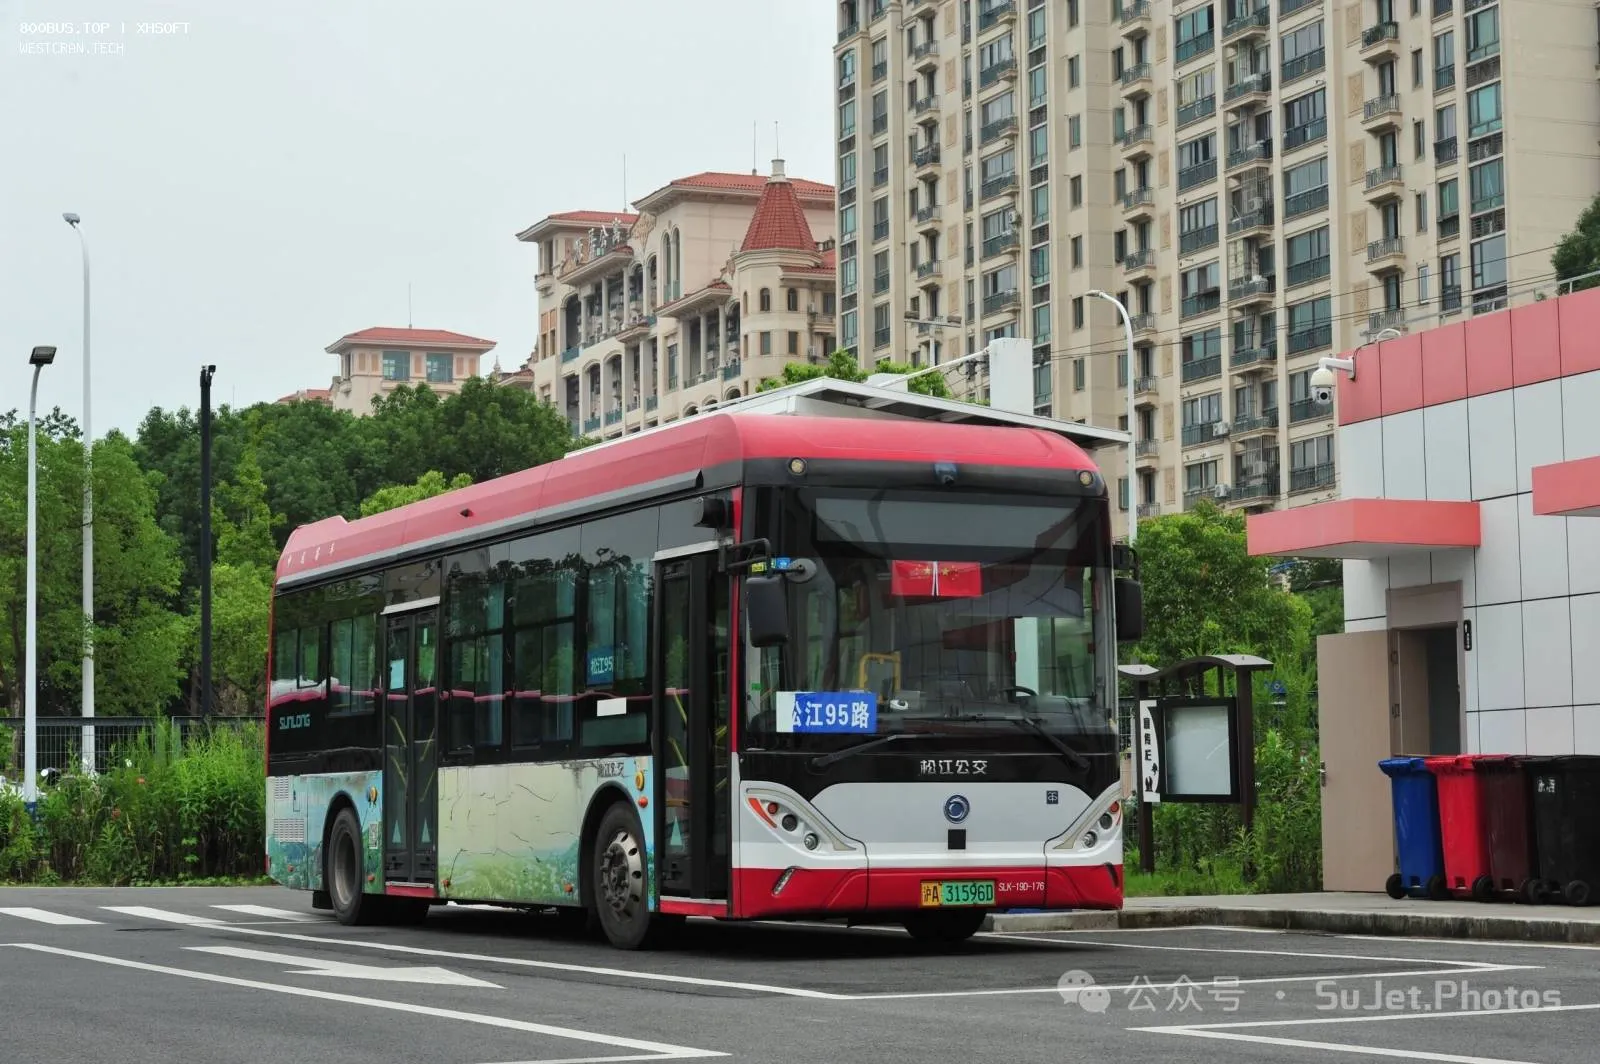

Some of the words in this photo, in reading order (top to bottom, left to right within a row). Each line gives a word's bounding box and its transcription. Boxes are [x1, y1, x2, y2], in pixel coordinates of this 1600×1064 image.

[279, 714, 310, 730] SUNLONG
[920, 759, 988, 775] 松江公交
[945, 884, 994, 903] 31596D
